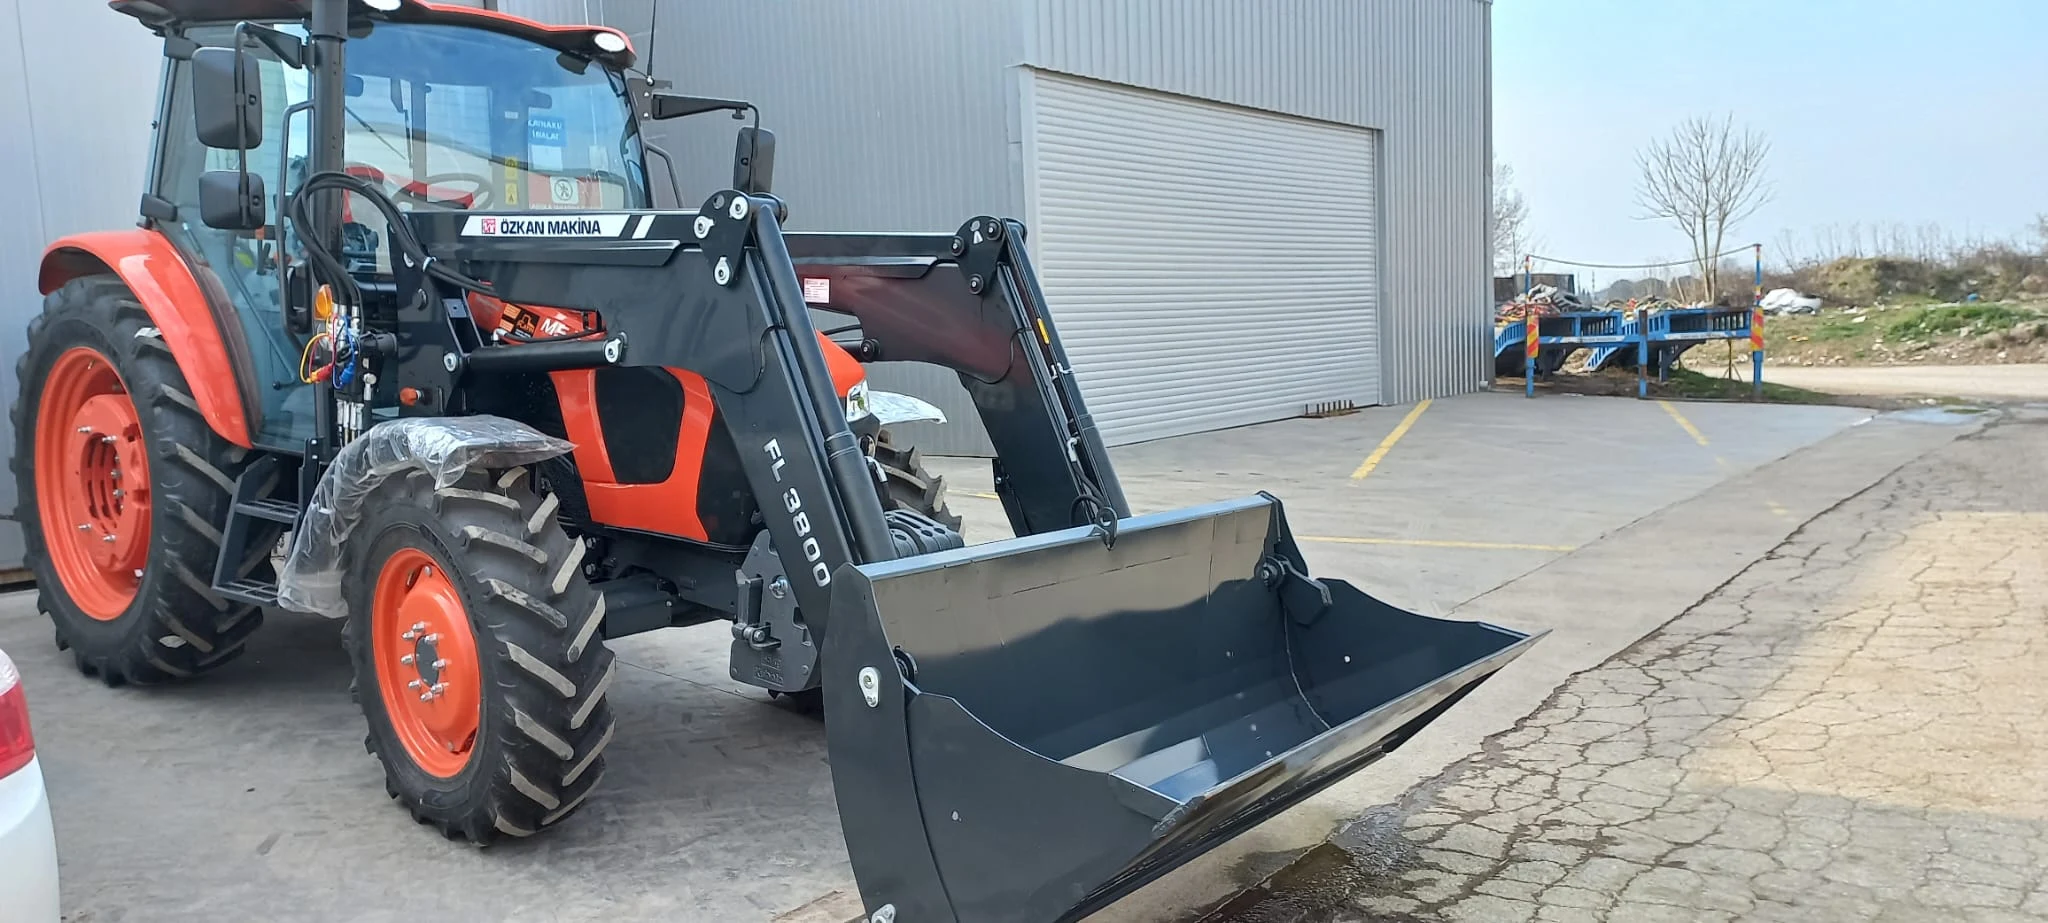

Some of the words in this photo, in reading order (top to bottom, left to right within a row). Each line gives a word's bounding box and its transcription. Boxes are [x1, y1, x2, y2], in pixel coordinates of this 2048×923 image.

[501, 218, 544, 235] ÖZKAN
[547, 217, 602, 235] MAKİNA
[763, 438, 786, 482] FL
[782, 487, 831, 587] 3800
